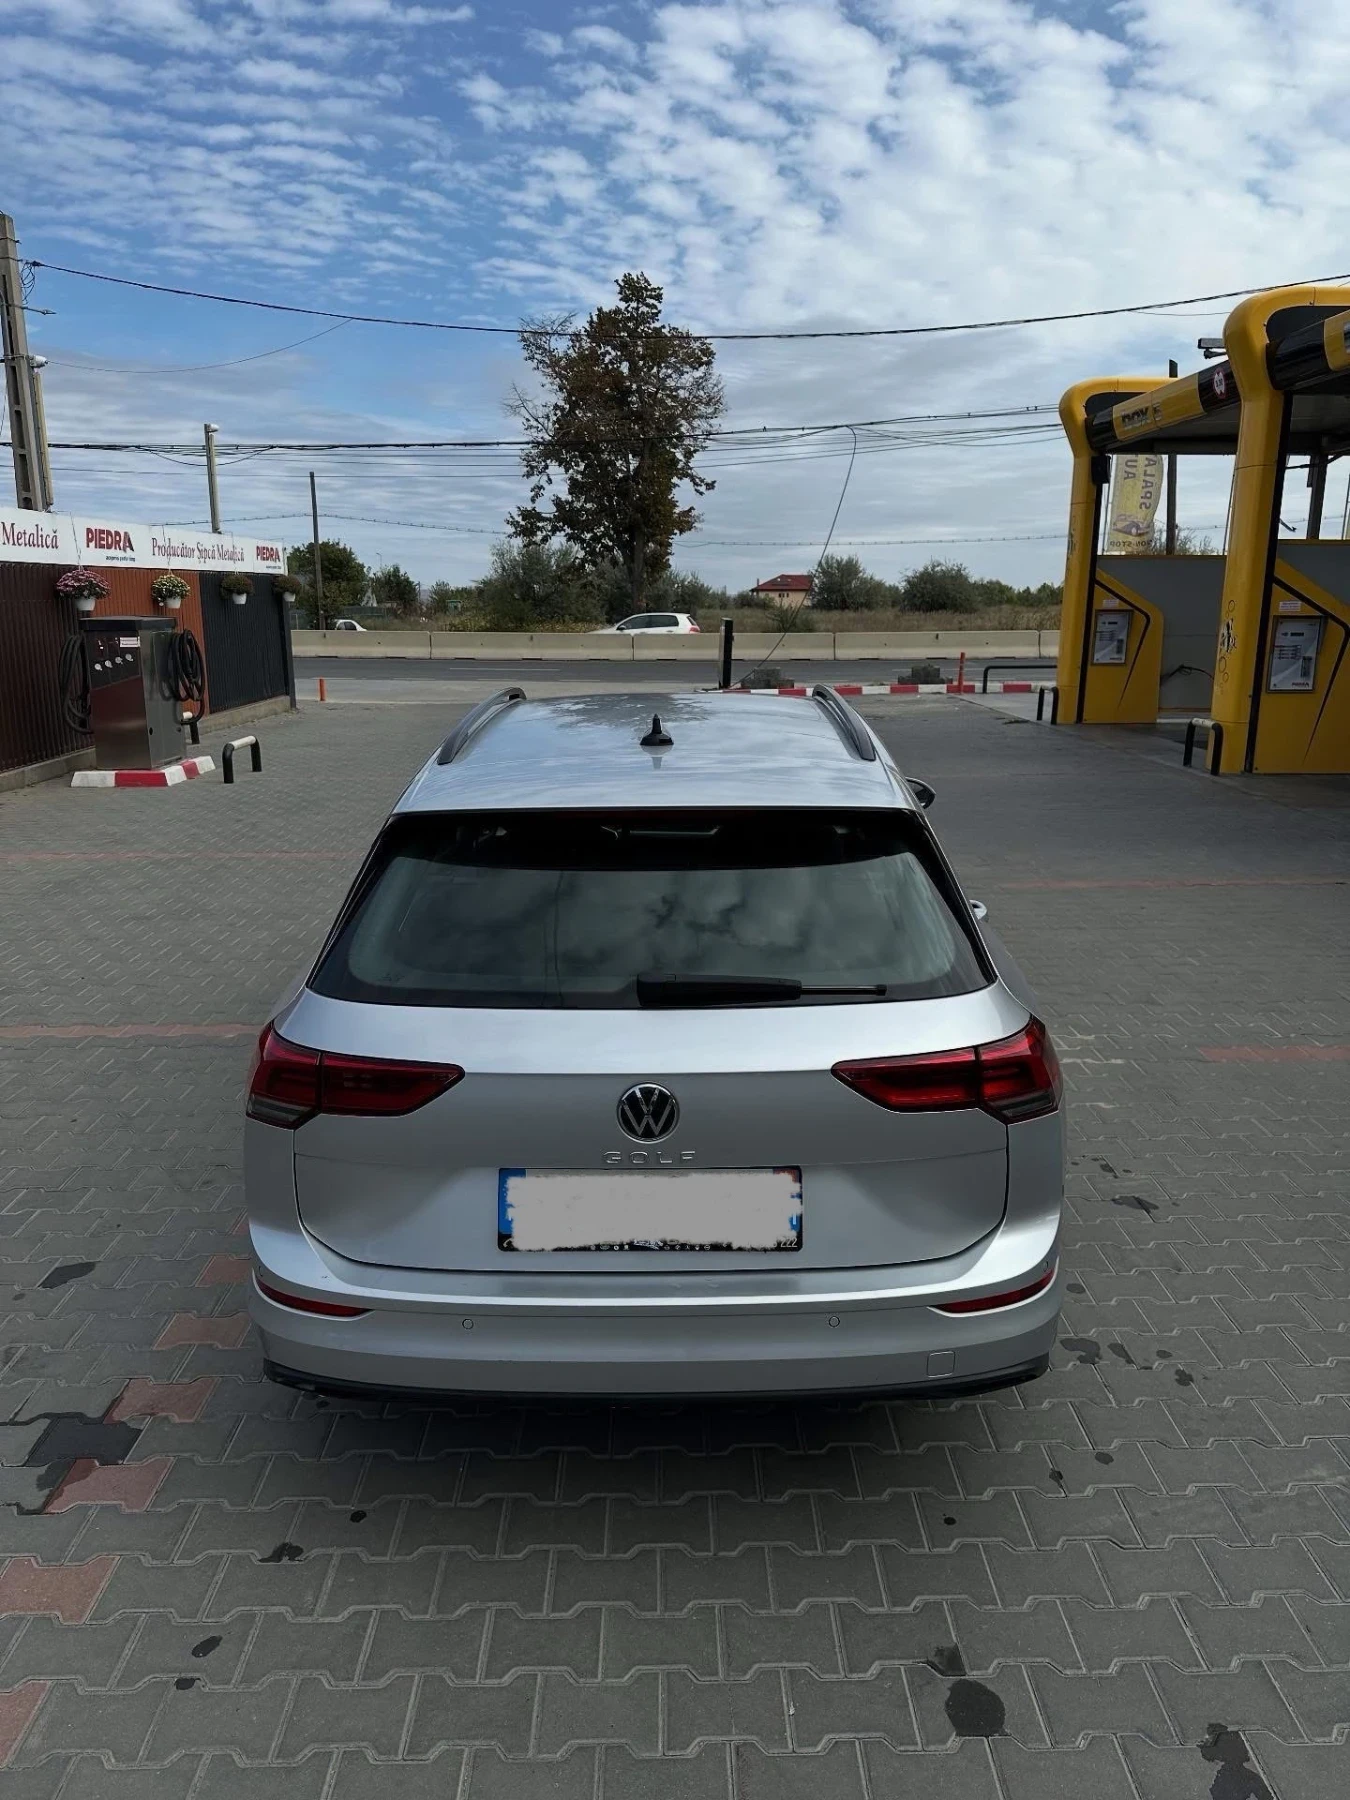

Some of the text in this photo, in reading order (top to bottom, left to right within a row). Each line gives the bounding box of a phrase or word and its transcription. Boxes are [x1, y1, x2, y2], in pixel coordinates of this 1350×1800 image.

[1, 521, 59, 549] Metalică
[85, 527, 135, 553] PIEDRA
[151, 537, 195, 559] Producător
[256, 545, 281, 562] PIEDRA
[603, 1150, 696, 1164] GOLF
